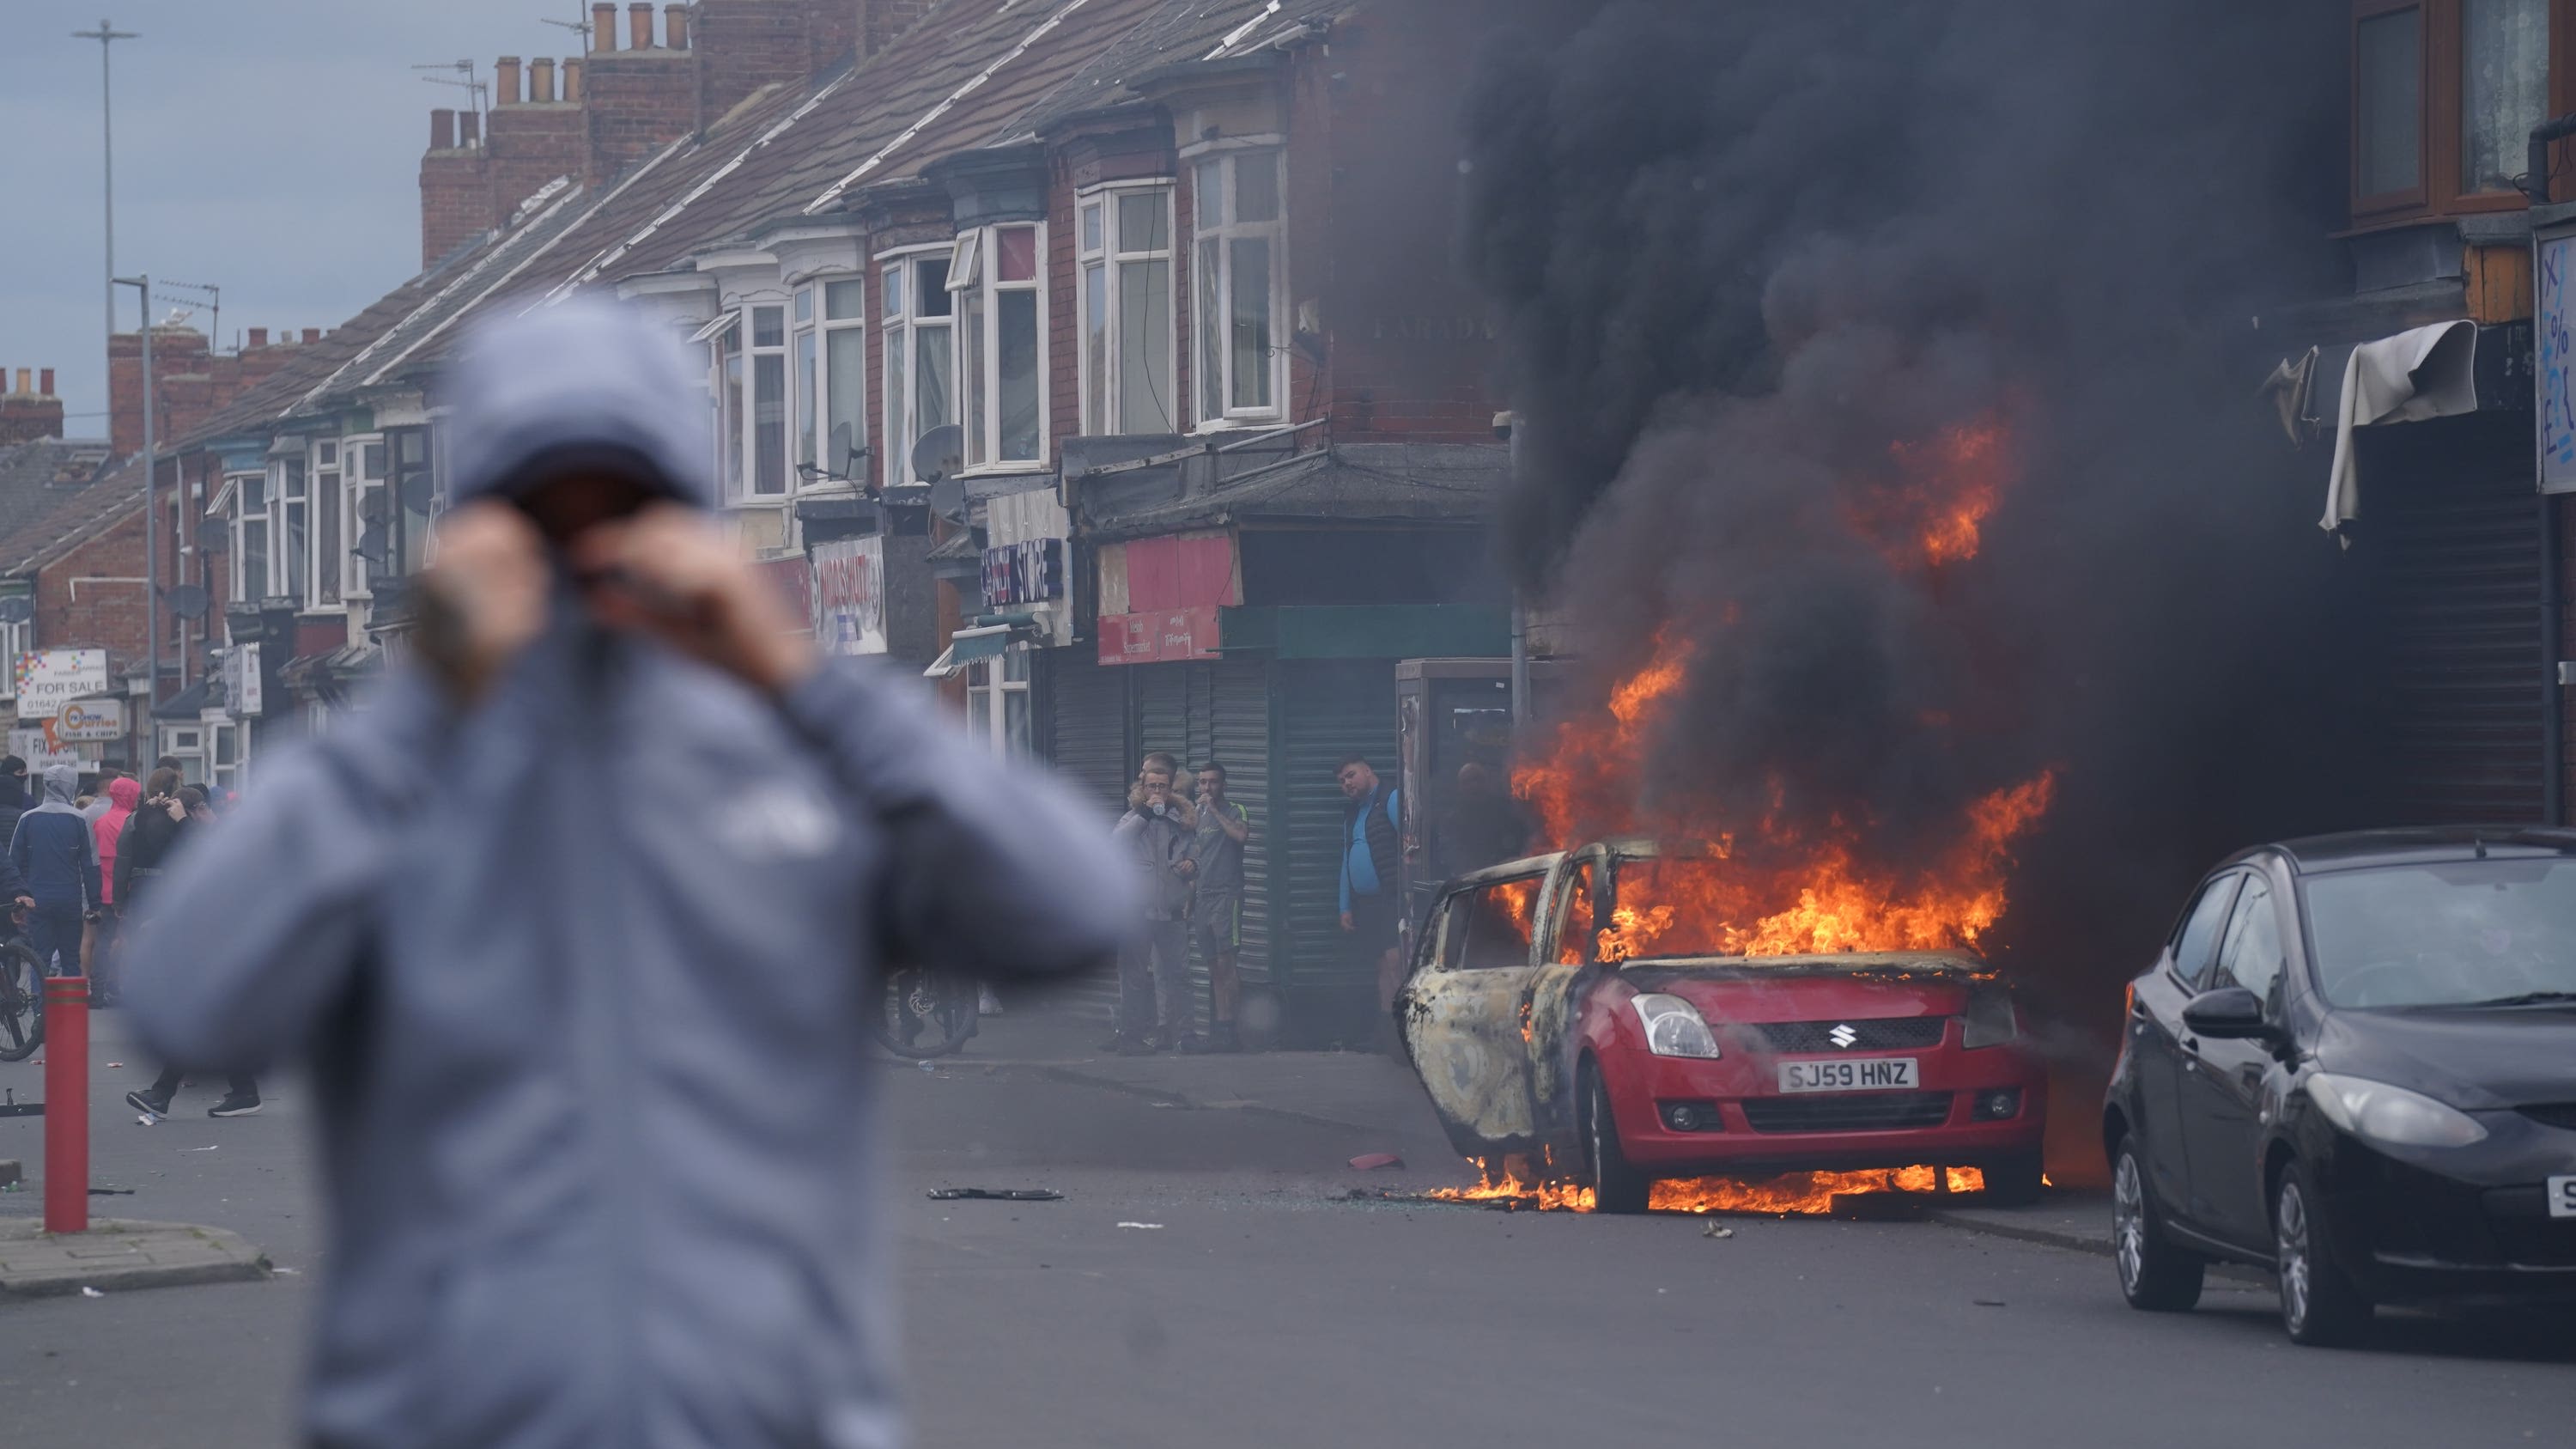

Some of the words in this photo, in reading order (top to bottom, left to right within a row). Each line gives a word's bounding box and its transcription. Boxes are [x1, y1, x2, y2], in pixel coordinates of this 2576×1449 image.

[1017, 539, 1048, 604] STORE
[36, 682, 64, 695] FOR
[69, 681, 103, 694] SALE
[33, 739, 46, 754] FIX
[1789, 1063, 1853, 1088] SJ59
[1860, 1062, 1908, 1086] HNZ
